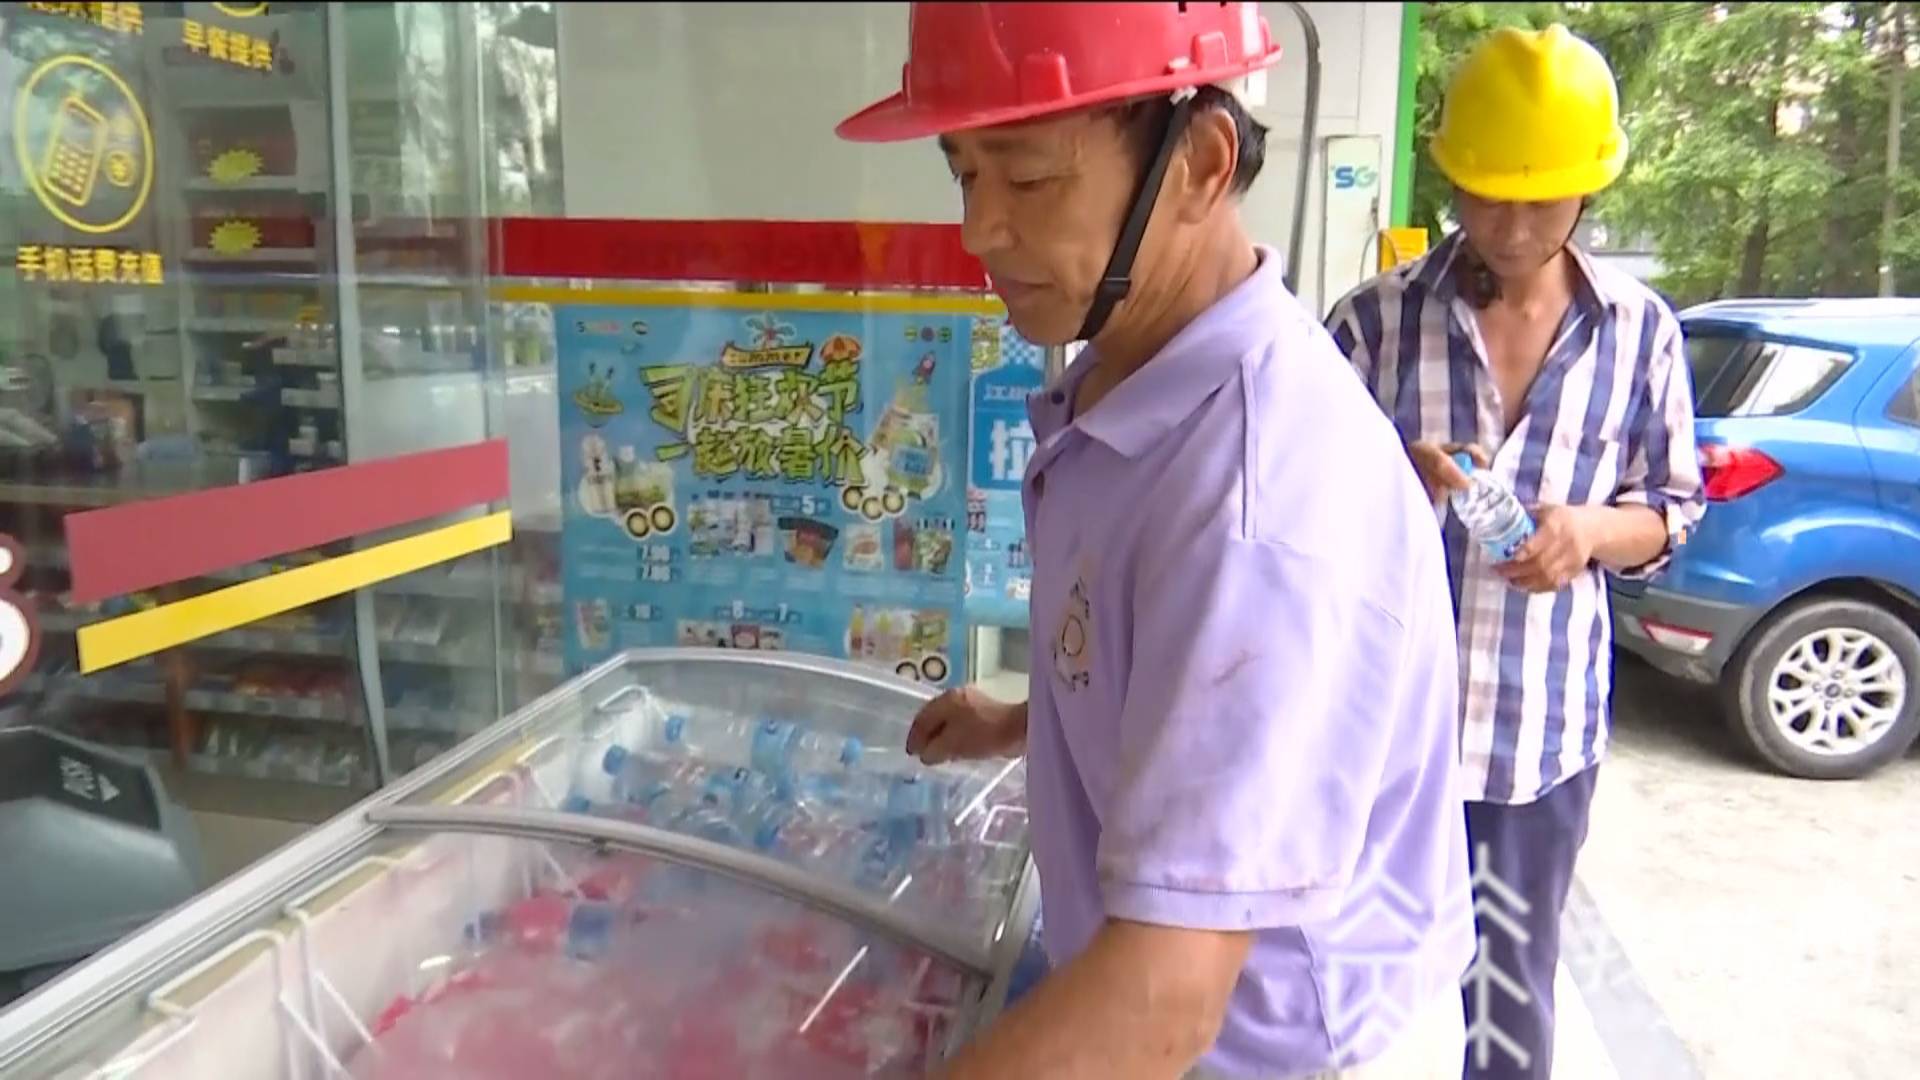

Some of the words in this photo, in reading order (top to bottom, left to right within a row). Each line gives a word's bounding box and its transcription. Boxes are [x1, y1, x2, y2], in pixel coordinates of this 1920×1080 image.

[1335, 166, 1378, 188] SG
[16, 246, 165, 285] 手机话费充值
